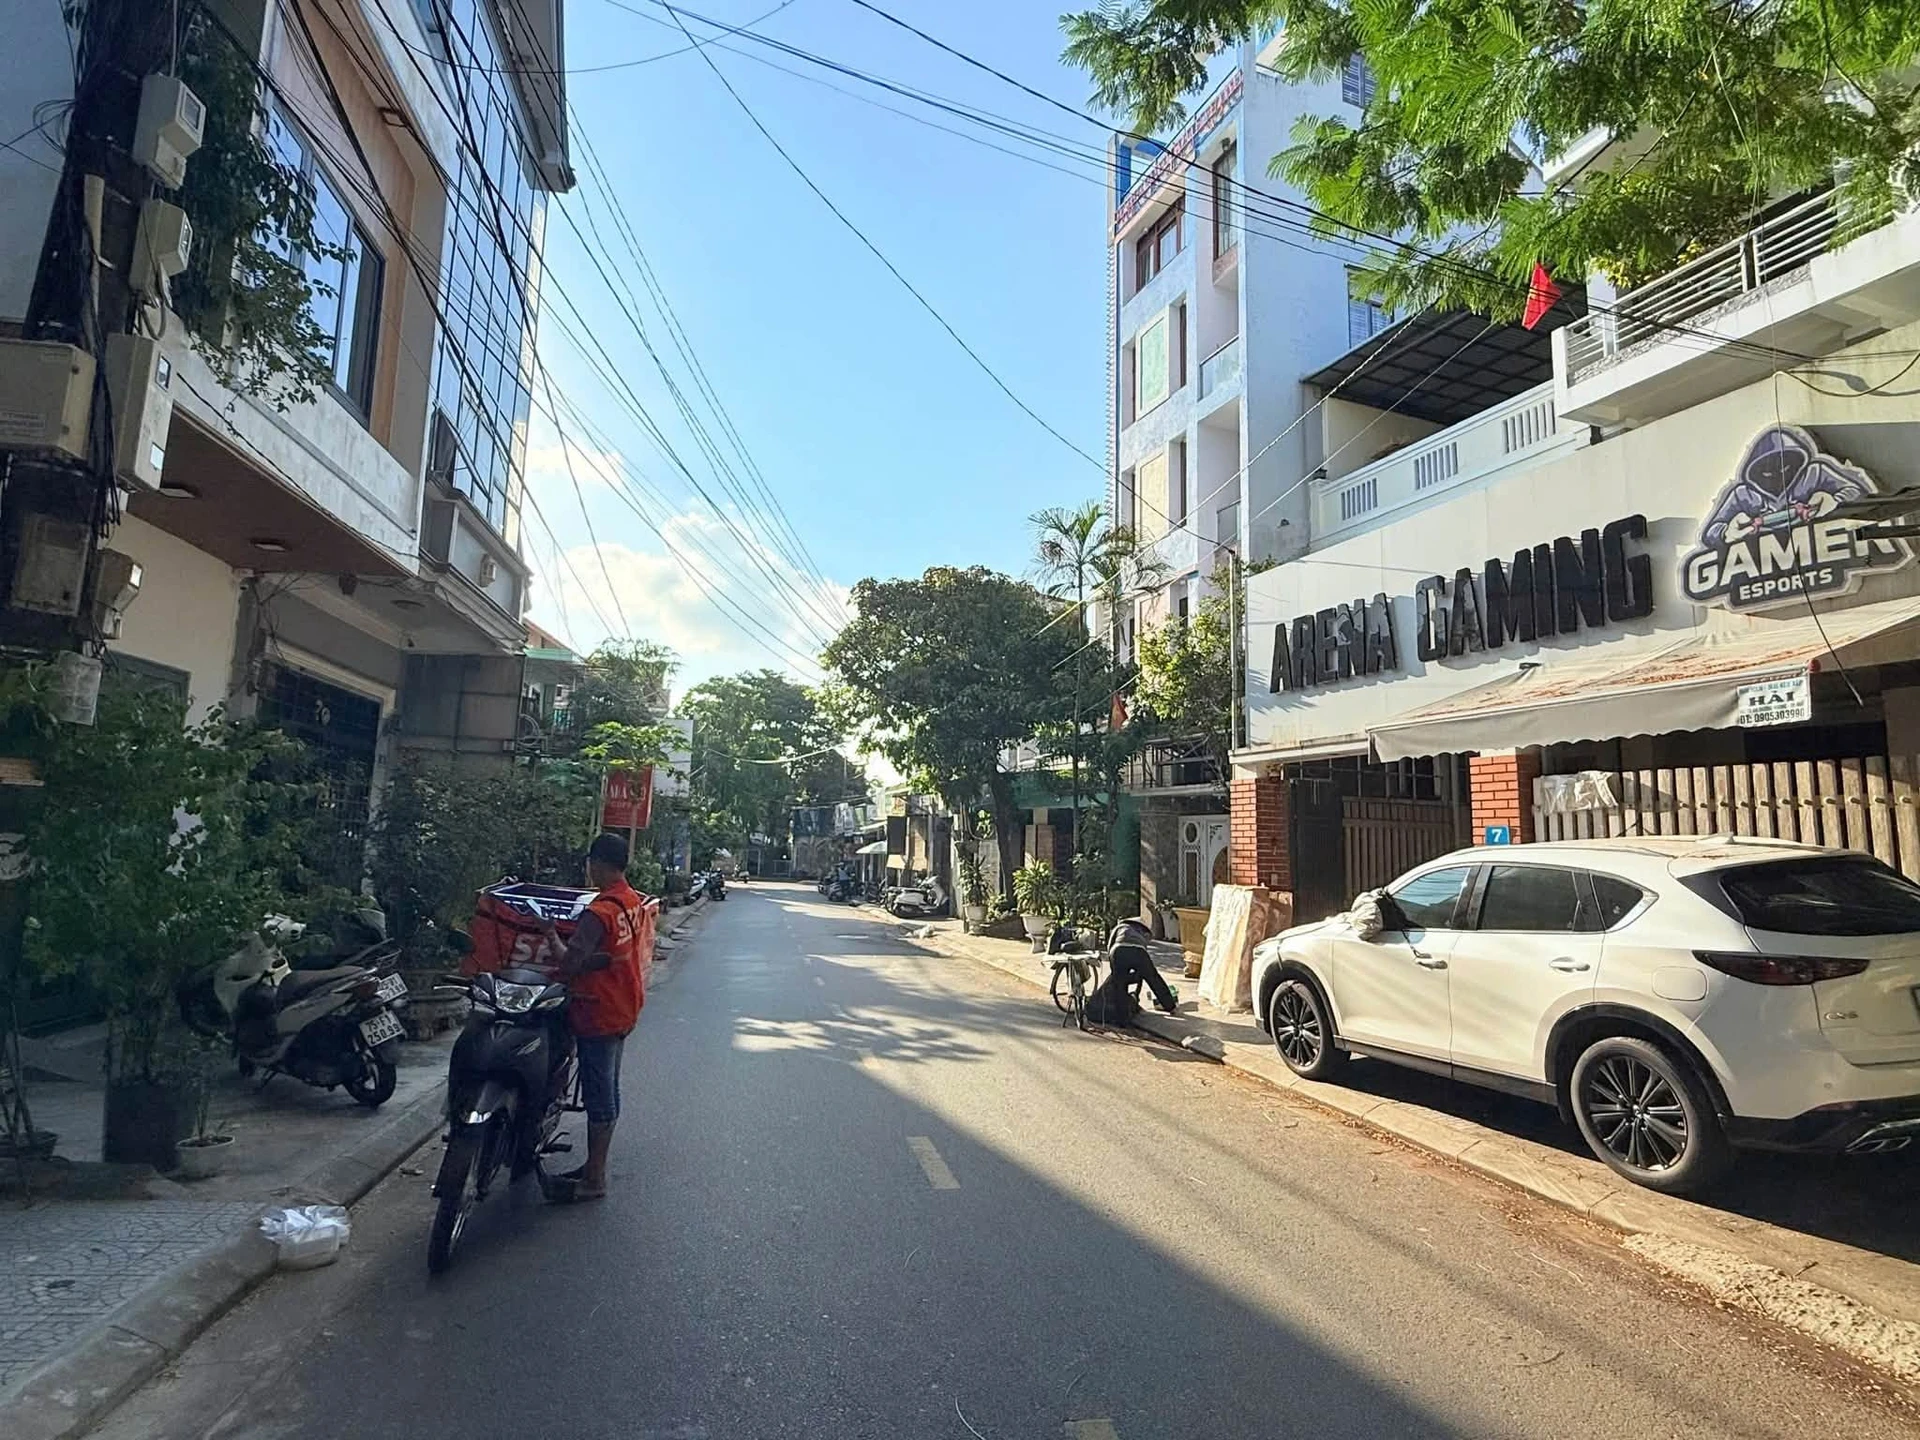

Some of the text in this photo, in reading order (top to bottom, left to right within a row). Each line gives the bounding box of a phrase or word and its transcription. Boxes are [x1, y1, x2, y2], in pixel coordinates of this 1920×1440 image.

[1740, 568, 1832, 600] ESPORTS
[1270, 514, 1653, 693] ARENA GAMING
[1491, 829, 1502, 842] 7
[511, 933, 553, 963] SP
